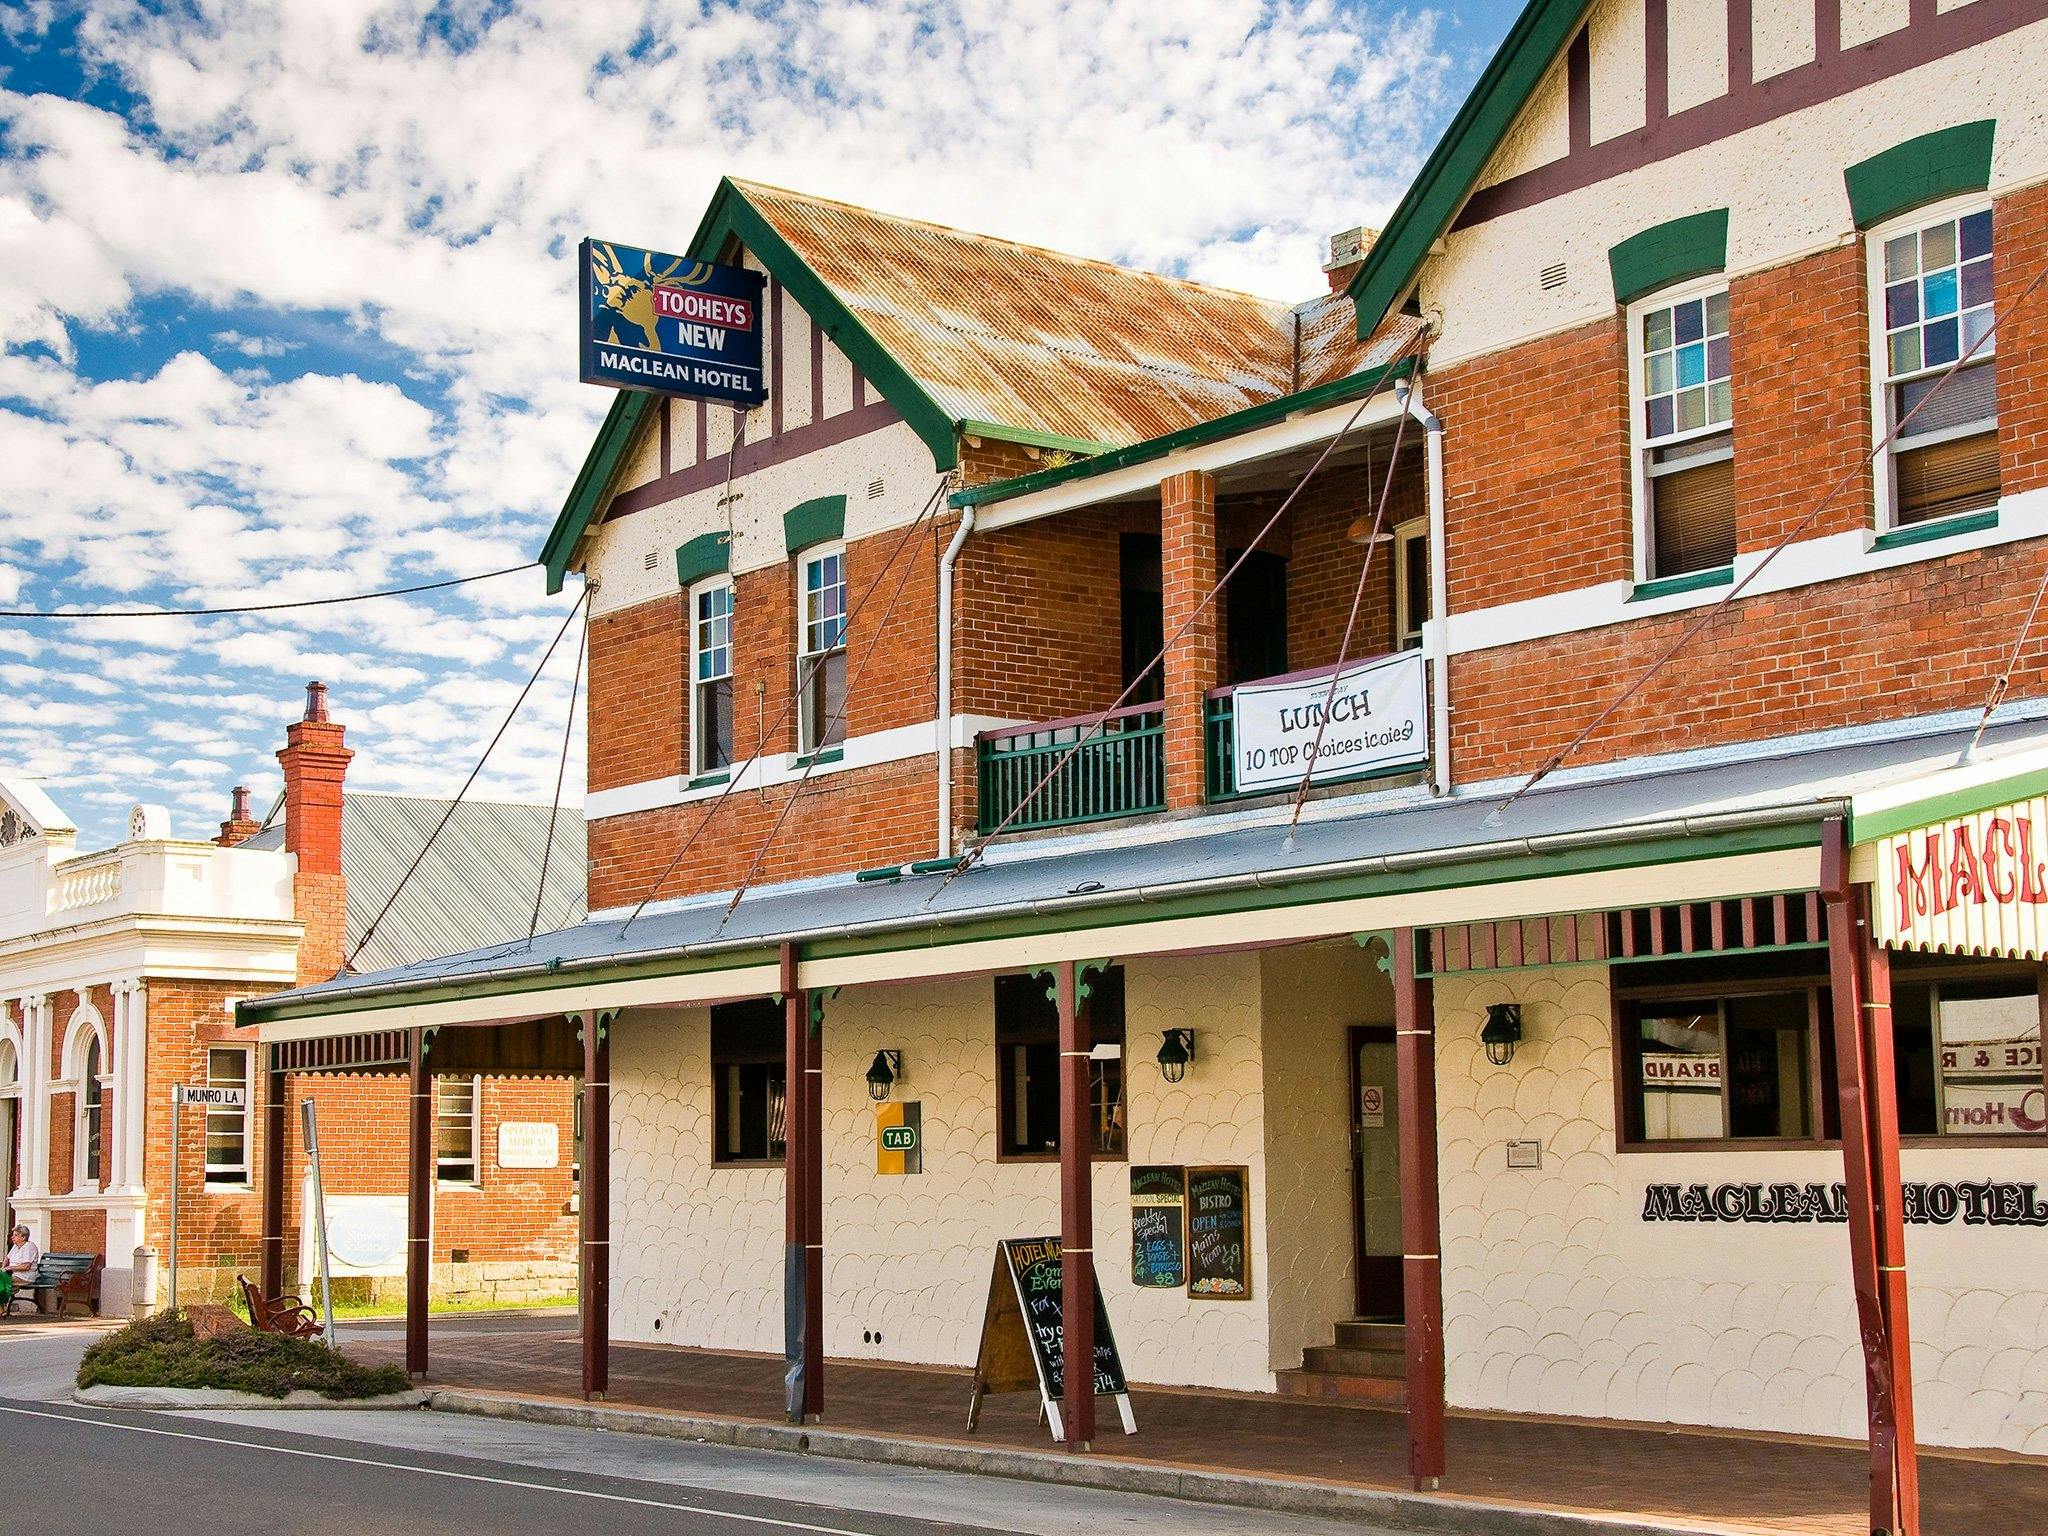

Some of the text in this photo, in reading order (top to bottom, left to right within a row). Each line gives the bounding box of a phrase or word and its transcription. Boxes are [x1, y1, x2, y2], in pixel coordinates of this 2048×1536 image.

[658, 290, 747, 325] TOOHEYS
[678, 322, 726, 351] NEW
[600, 352, 752, 392] MACLEAN HOTEL
[1279, 690, 1371, 733] LUNCH
[1246, 748, 1266, 771] 10
[1269, 745, 1299, 767] TOP
[1303, 738, 1363, 761] Choices
[187, 1089, 238, 1103] MUNRO LA
[886, 1131, 911, 1145] TAB
[1199, 1194, 1232, 1211] BISTRO
[1901, 1177, 2048, 1226] HOTEL
[1192, 1215, 1217, 1232] OPEN
[1191, 1229, 1220, 1258] Mains
[1010, 1244, 1046, 1276] HOTEL
[1154, 1271, 1175, 1285] $8
